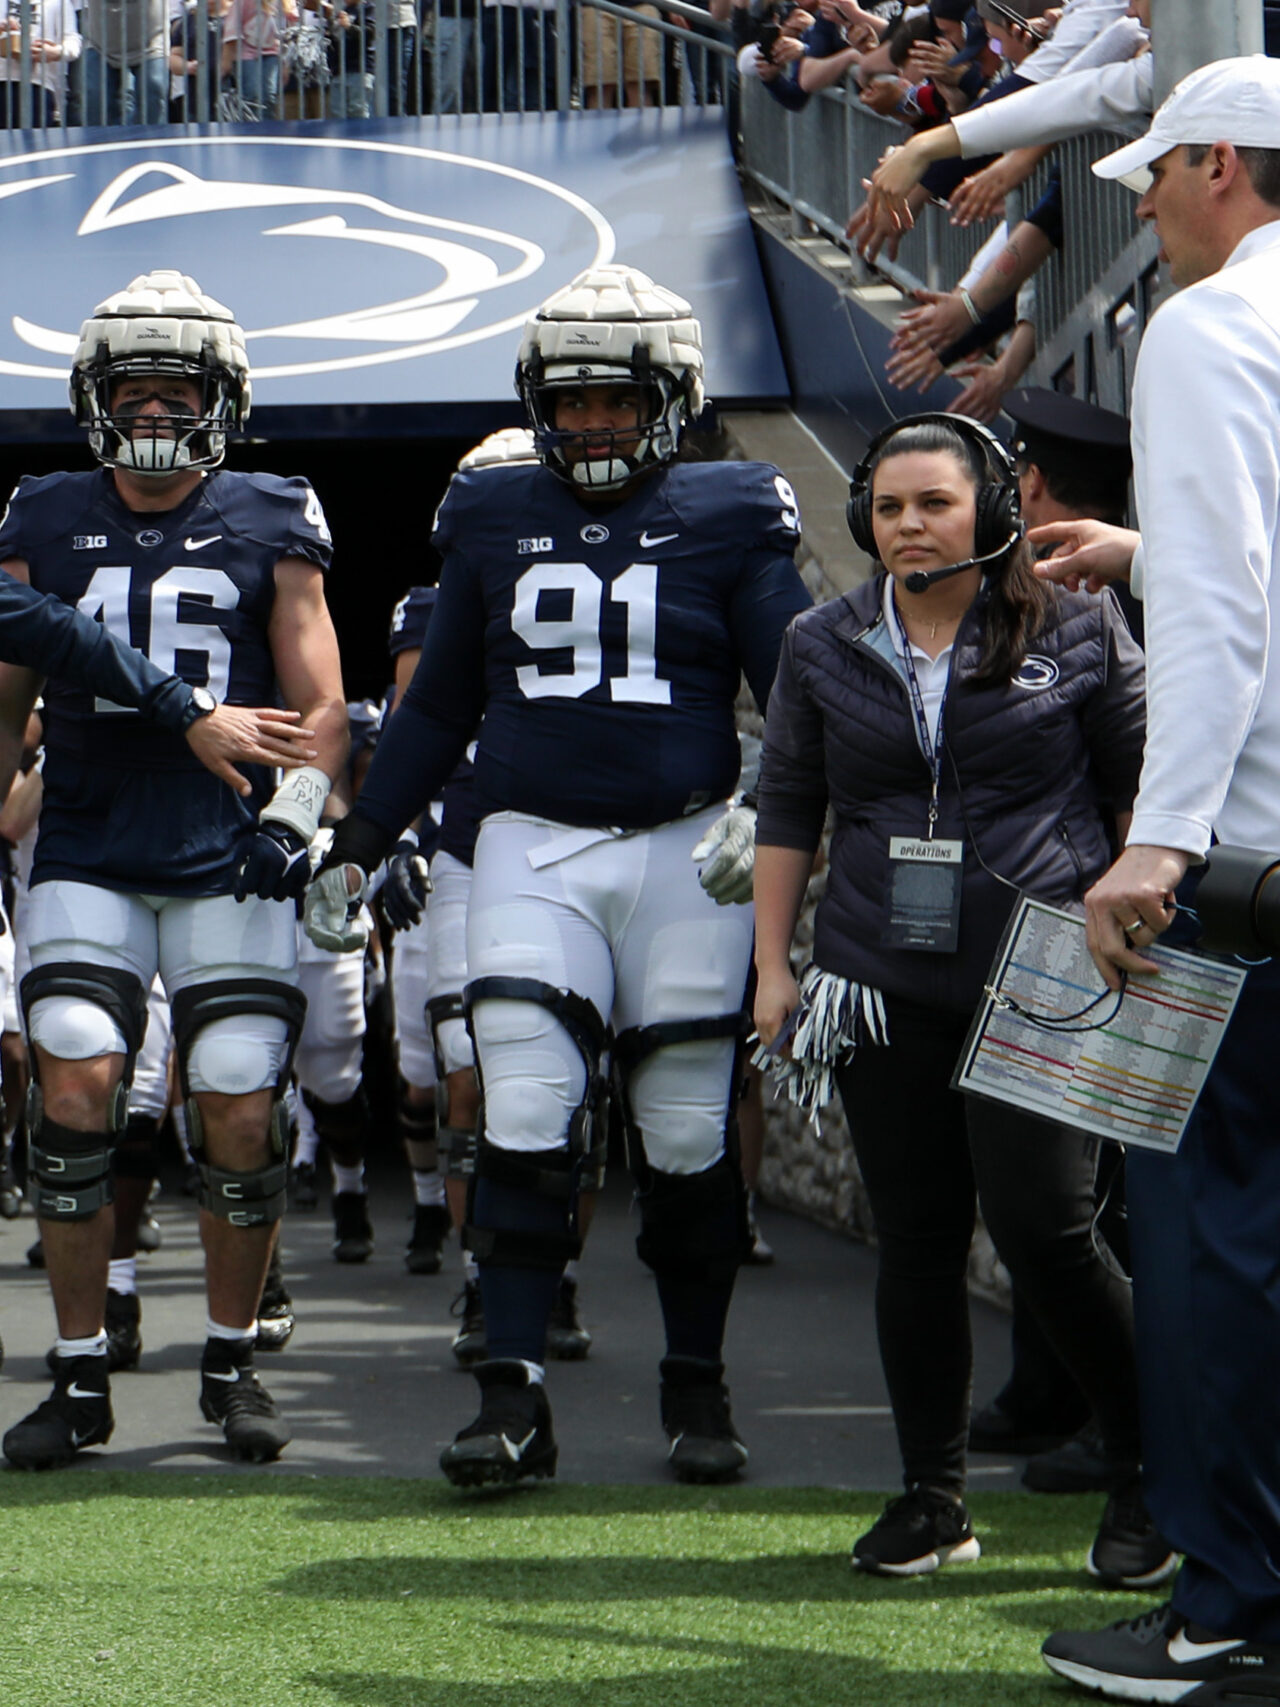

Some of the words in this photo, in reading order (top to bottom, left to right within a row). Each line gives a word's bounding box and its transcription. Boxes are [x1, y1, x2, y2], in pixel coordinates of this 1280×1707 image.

[73, 565, 241, 713] 46
[511, 562, 672, 706] 91
[900, 845, 951, 859] OPERATIONS
